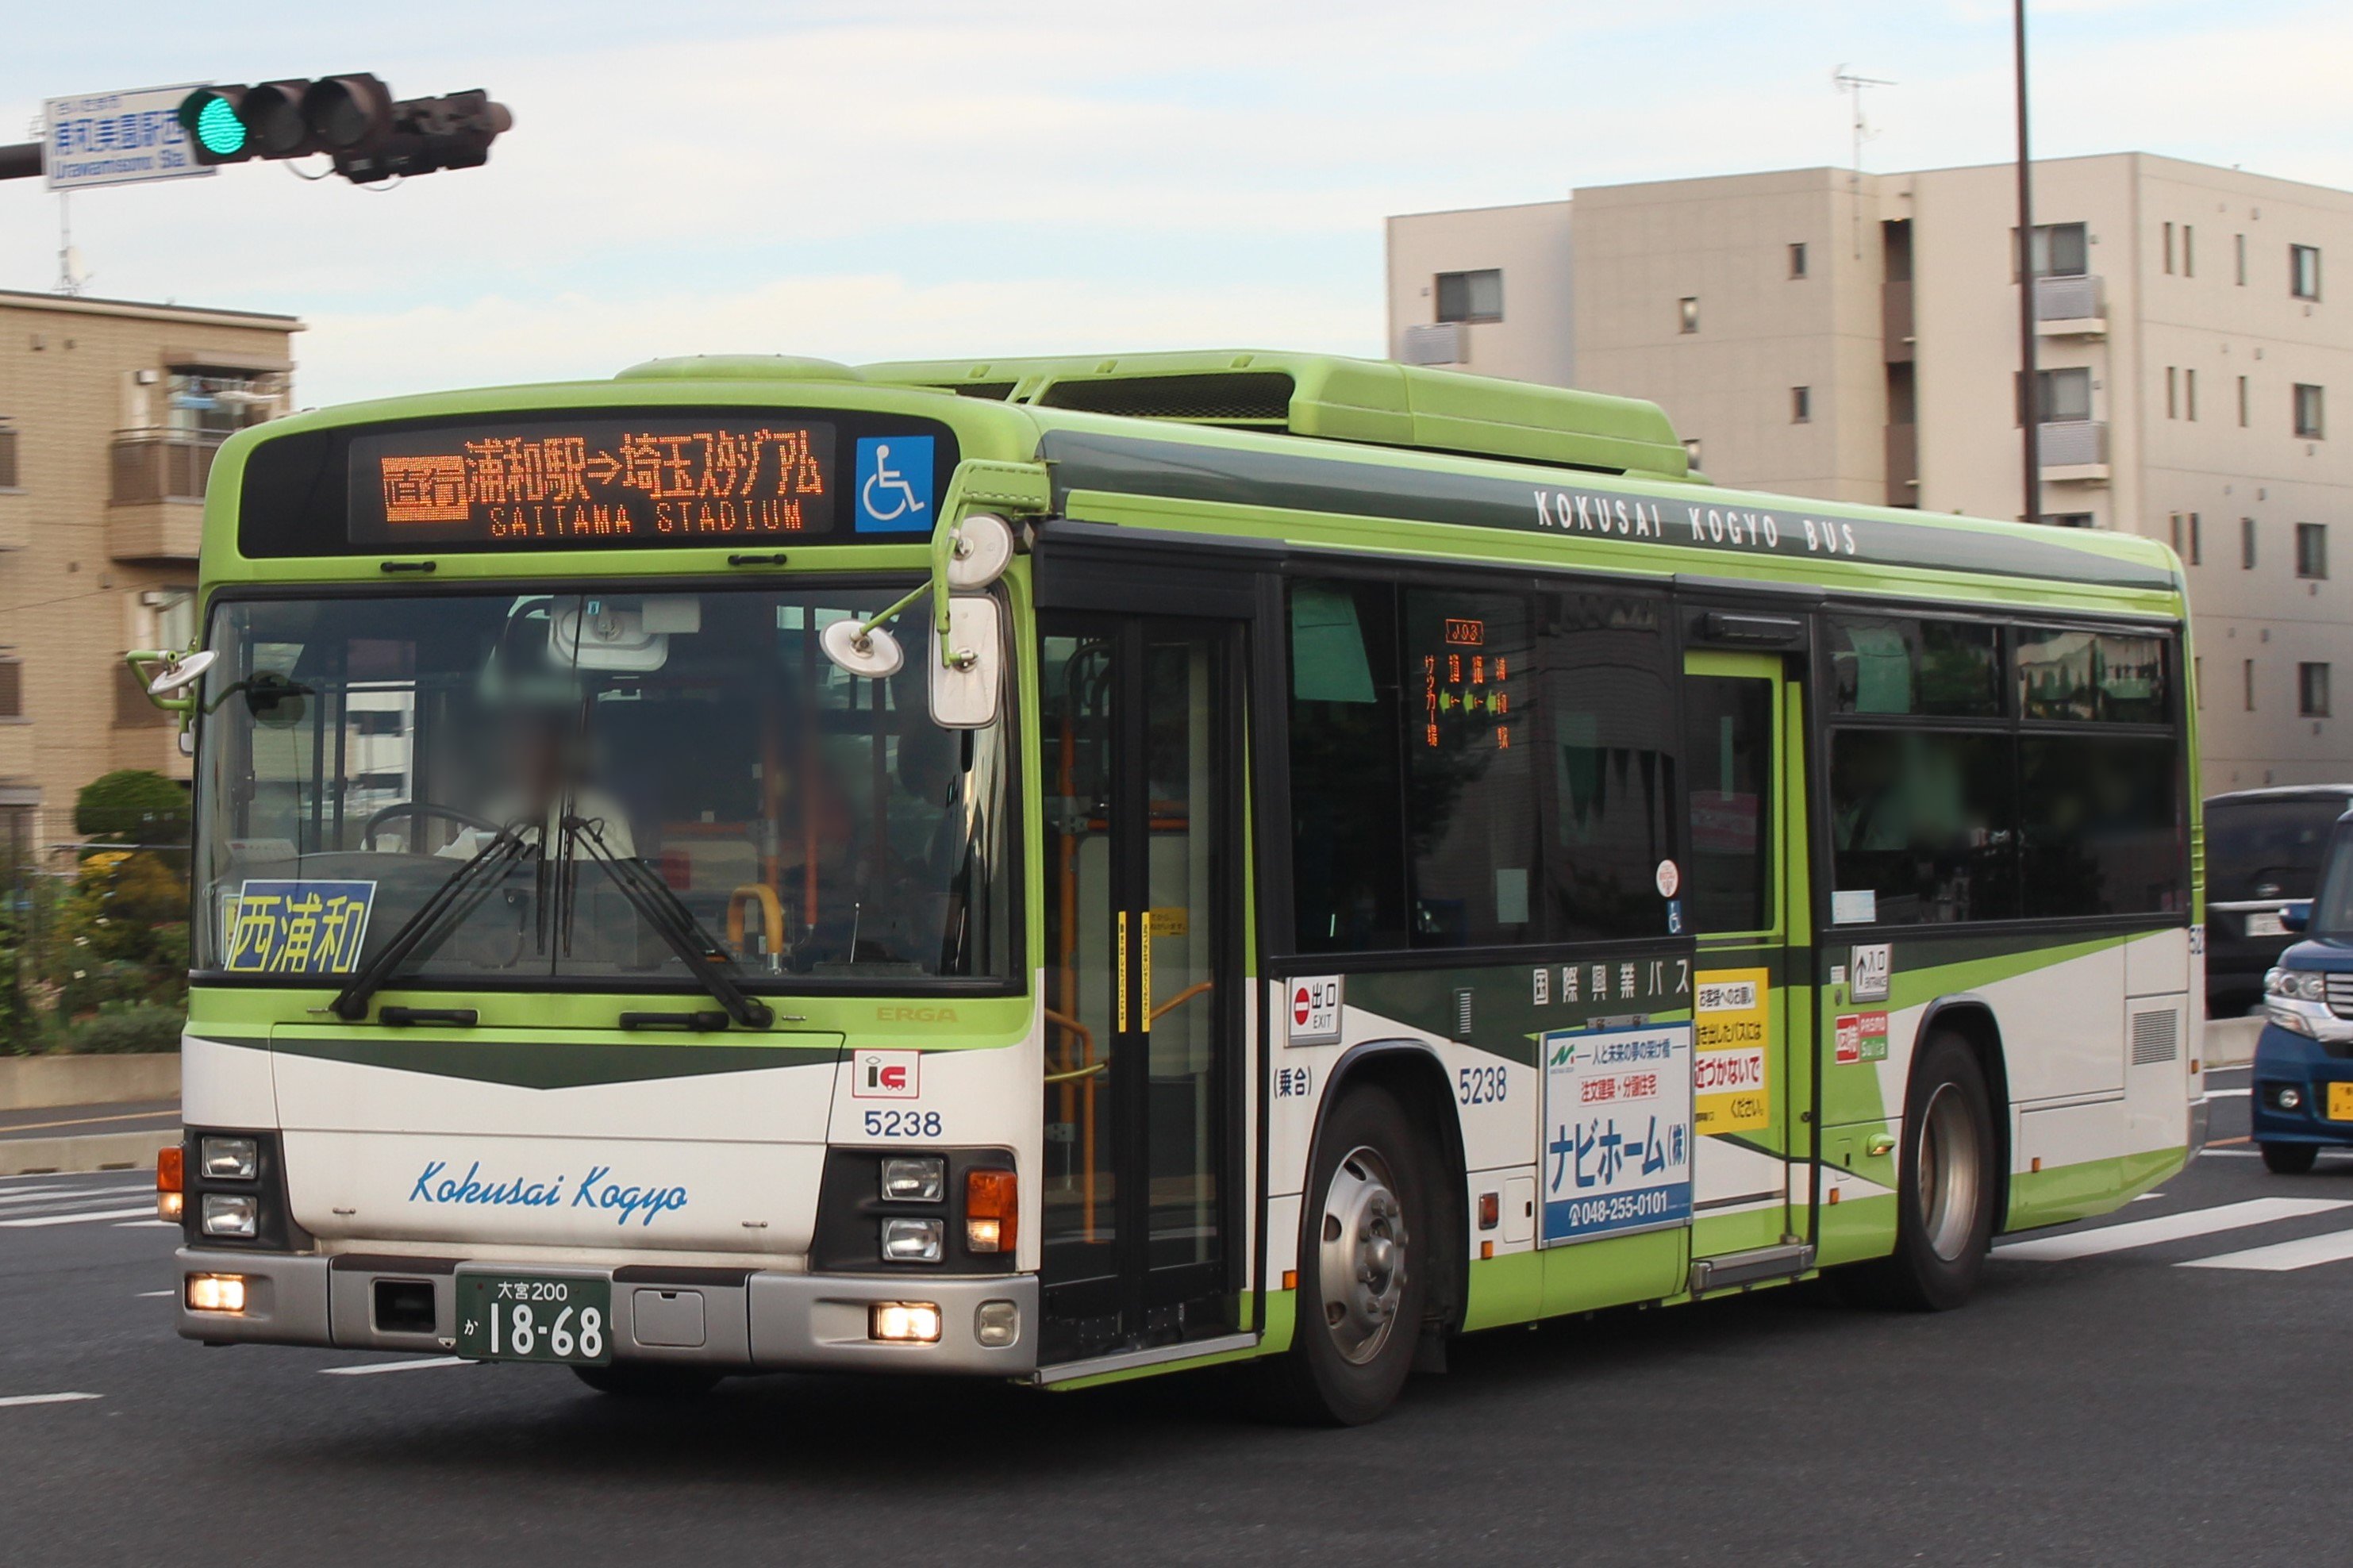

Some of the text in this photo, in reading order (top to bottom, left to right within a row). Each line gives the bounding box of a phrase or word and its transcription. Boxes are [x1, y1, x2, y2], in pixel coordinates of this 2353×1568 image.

[383, 463, 467, 510] 直行
[490, 498, 802, 536] SAITAMA STADIUM
[1534, 490, 1856, 555] KOKUSAI KOGYO BUS
[228, 891, 365, 973] 西浦和
[1867, 951, 1886, 973] 入口
[1312, 982, 1336, 1009] 出口
[1532, 959, 1690, 1005] 国際興業バス
[876, 1007, 959, 1023] ERGA
[1313, 1013, 1332, 1029] EXIT
[1274, 1065, 1313, 1100] (乗合)
[1459, 1065, 1507, 1105] 5238
[1694, 1055, 1760, 1089] 近づかないで
[864, 1110, 943, 1137] 5238
[409, 1160, 688, 1226] Kokusai Kogyo
[1582, 1190, 1667, 1224] 048-255-0101
[498, 1281, 568, 1302] 大宮200
[464, 1319, 479, 1336] か
[490, 1302, 603, 1359] 18-68
